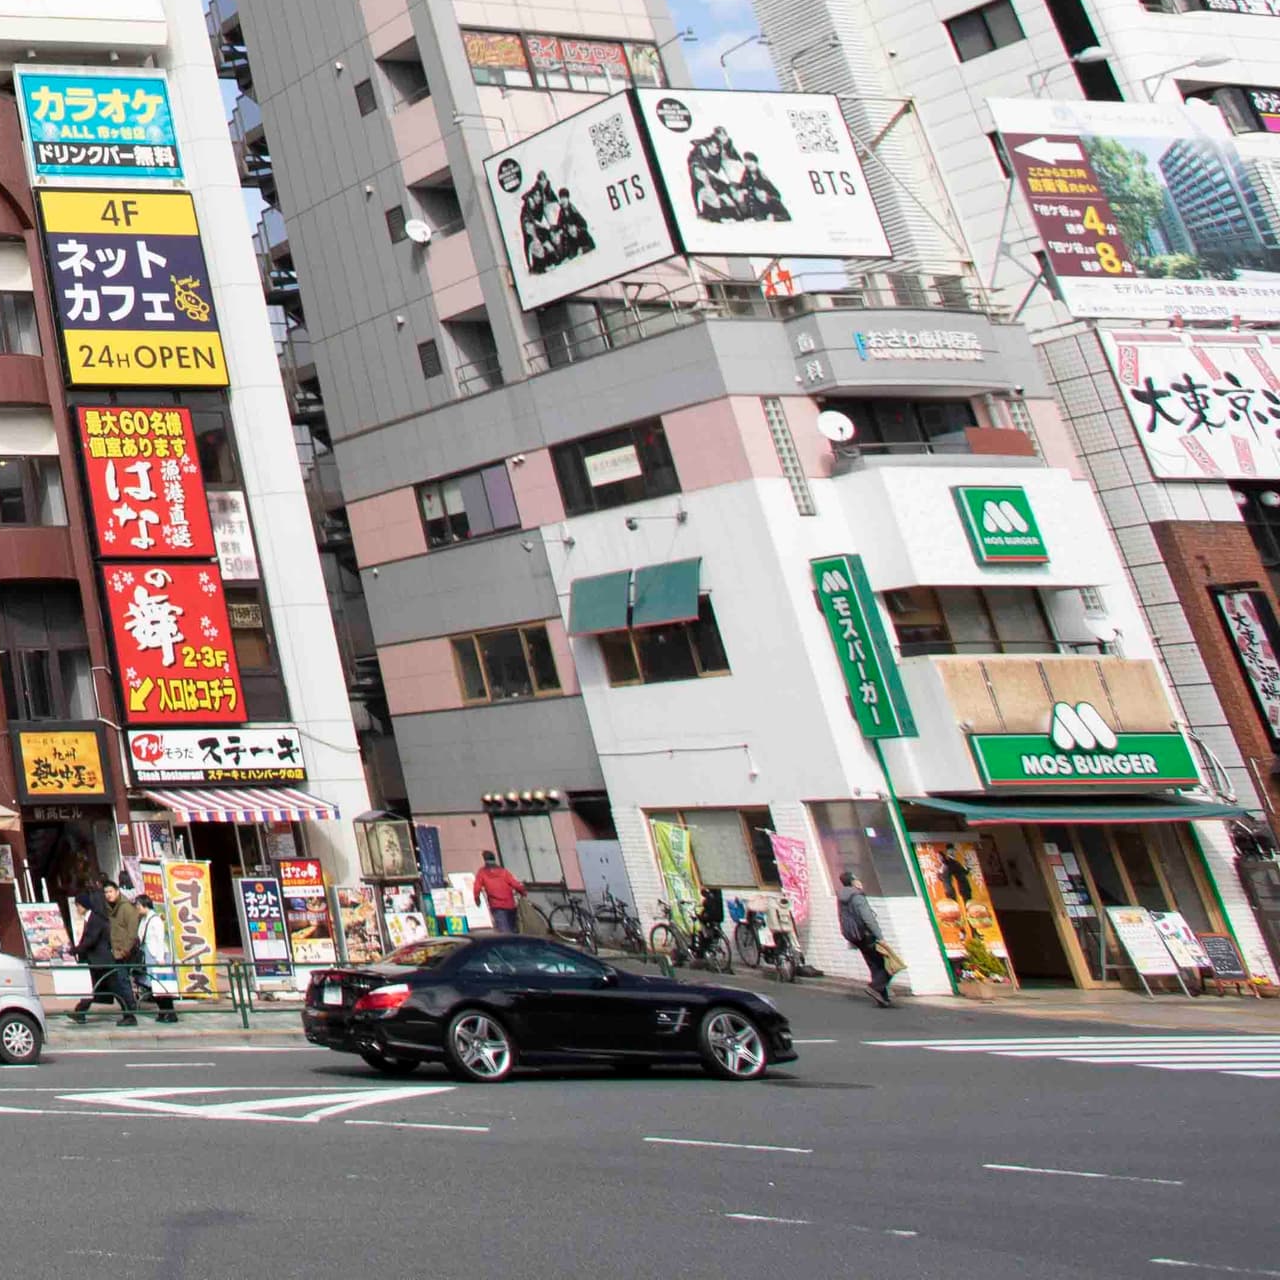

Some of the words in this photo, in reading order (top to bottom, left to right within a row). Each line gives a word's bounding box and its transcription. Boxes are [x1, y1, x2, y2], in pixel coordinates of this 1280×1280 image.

[31, 85, 163, 124] カラオケ
[61, 125, 96, 139] ALL
[40, 144, 175, 167] ドリンクバー無料
[606, 174, 646, 211] BTS
[808, 170, 856, 196] BTS
[101, 200, 139, 228] 4F
[57, 239, 168, 279] ネット
[64, 285, 176, 323] カフェ
[134, 344, 216, 370] OPEN
[1130, 371, 1280, 442] 大東京
[86, 410, 183, 436] 最大60名様
[88, 436, 187, 458] 個室あります
[160, 459, 194, 548] 漁港直送
[984, 536, 1006, 546] MOS
[1006, 536, 1041, 546] BURGER
[831, 597, 882, 727] モスバーガー
[157, 677, 237, 712] 入口はコチラ
[52, 746, 77, 761] 九州
[164, 747, 195, 761] そうだ
[197, 734, 300, 766] ステーキ
[207, 769, 305, 781] ステーキとハンバーグの店
[1021, 754, 1074, 776] MOS
[1075, 753, 1160, 777] BURGER
[245, 891, 278, 906] ネット
[247, 906, 280, 919] カフェ
[173, 877, 212, 994] オムライス
